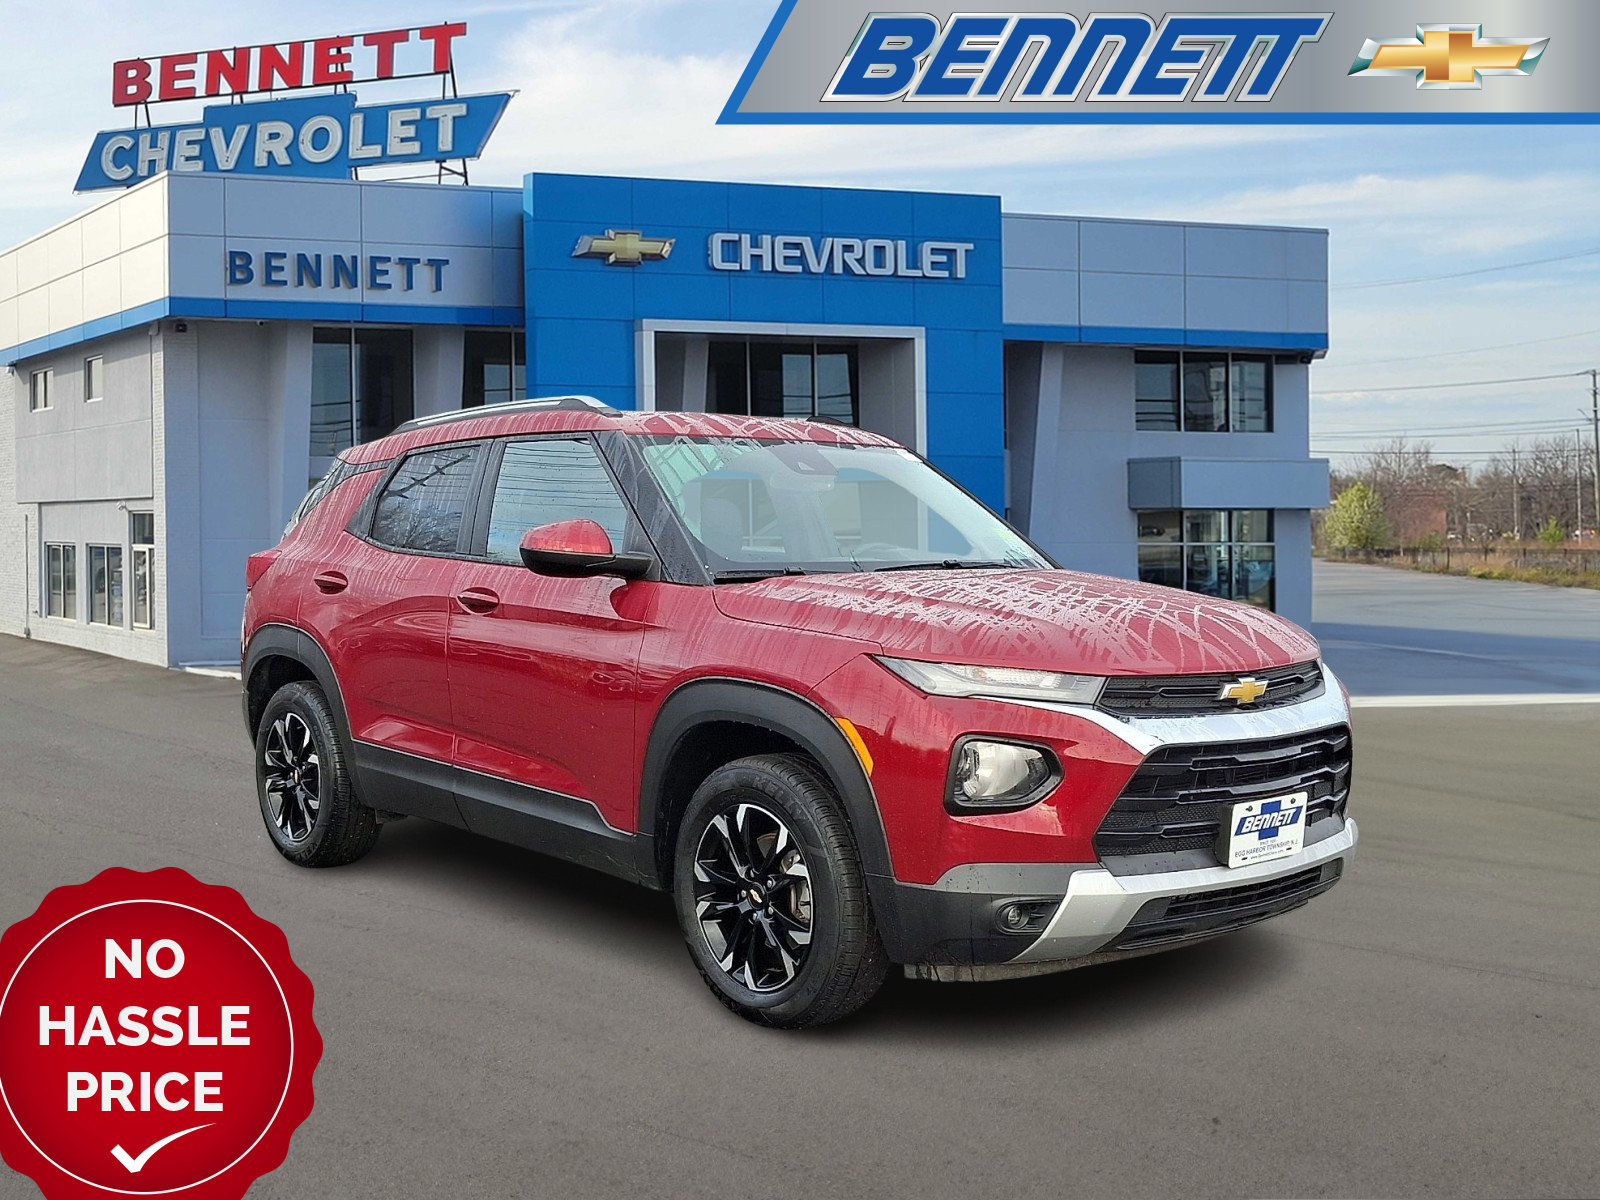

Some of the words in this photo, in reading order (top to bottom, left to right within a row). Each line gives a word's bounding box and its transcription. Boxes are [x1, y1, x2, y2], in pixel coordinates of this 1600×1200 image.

[112, 22, 467, 106] BENNETT
[99, 103, 468, 181] CHEVROLET
[227, 250, 450, 292] BENNETT
[708, 232, 974, 279] CHEVROLET
[1240, 808, 1297, 833] BENNETT
